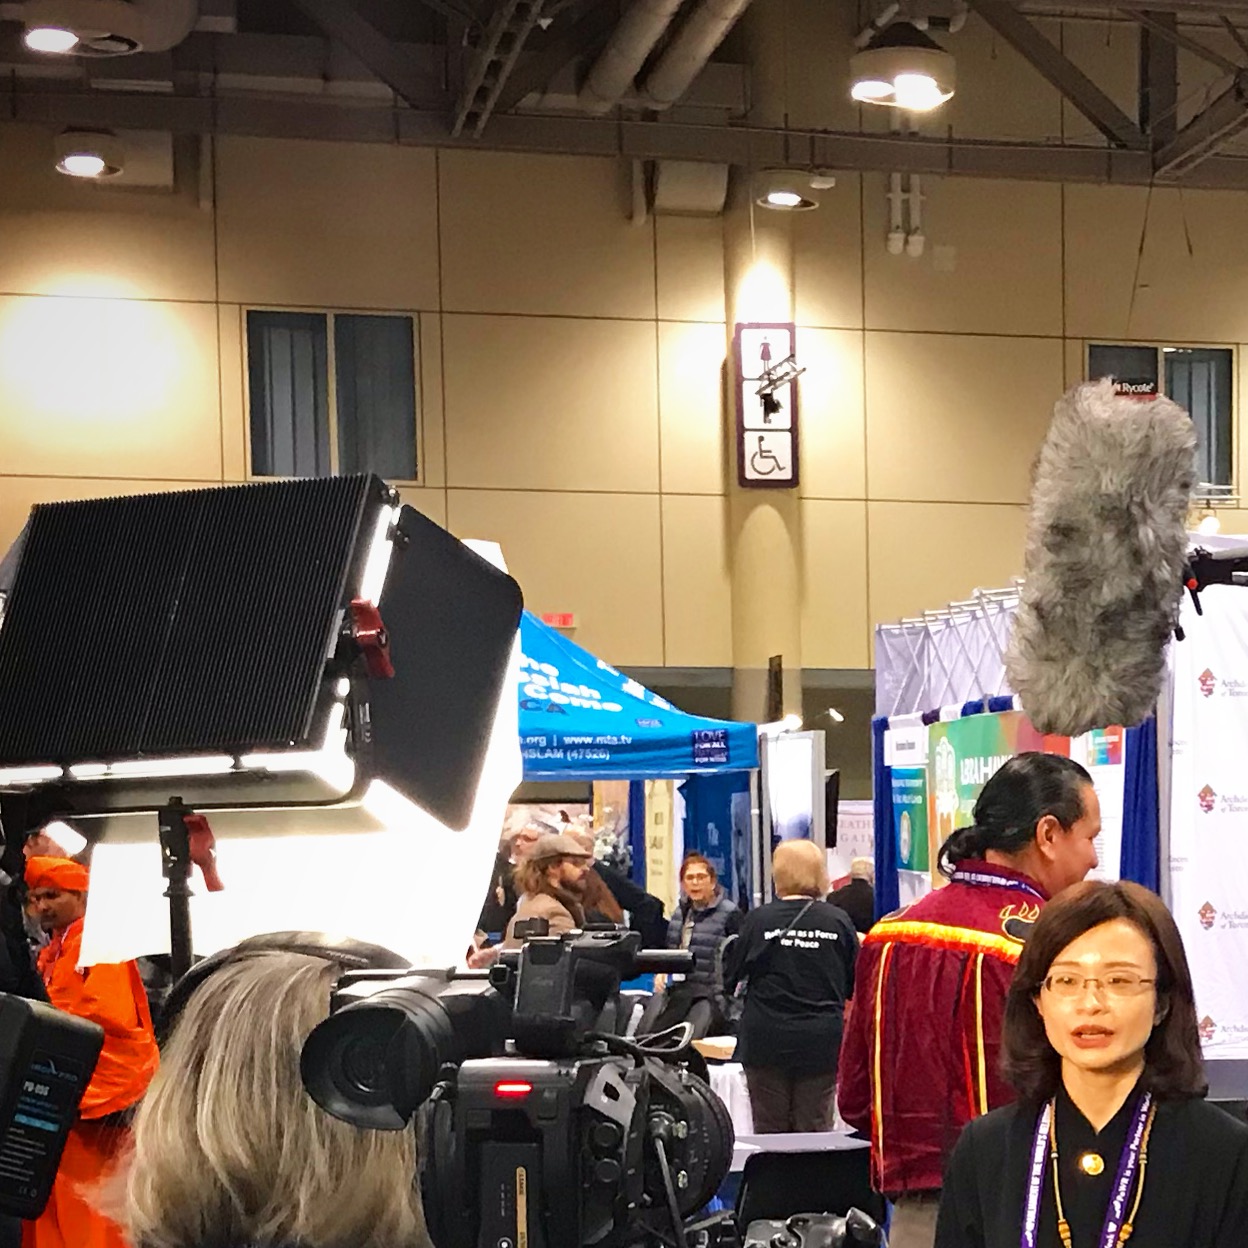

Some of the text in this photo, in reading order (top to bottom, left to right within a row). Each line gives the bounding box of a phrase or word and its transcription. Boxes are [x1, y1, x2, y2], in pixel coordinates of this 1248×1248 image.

[563, 734, 633, 745] www.mta.tv
[797, 930, 807, 938] as
[808, 930, 814, 938] a
[815, 930, 838, 940] Force
[780, 938, 820, 948] for Peace
[1139, 1114, 1146, 1122] in
[1130, 1122, 1144, 1150] Partner
[1127, 1151, 1136, 1168] your
